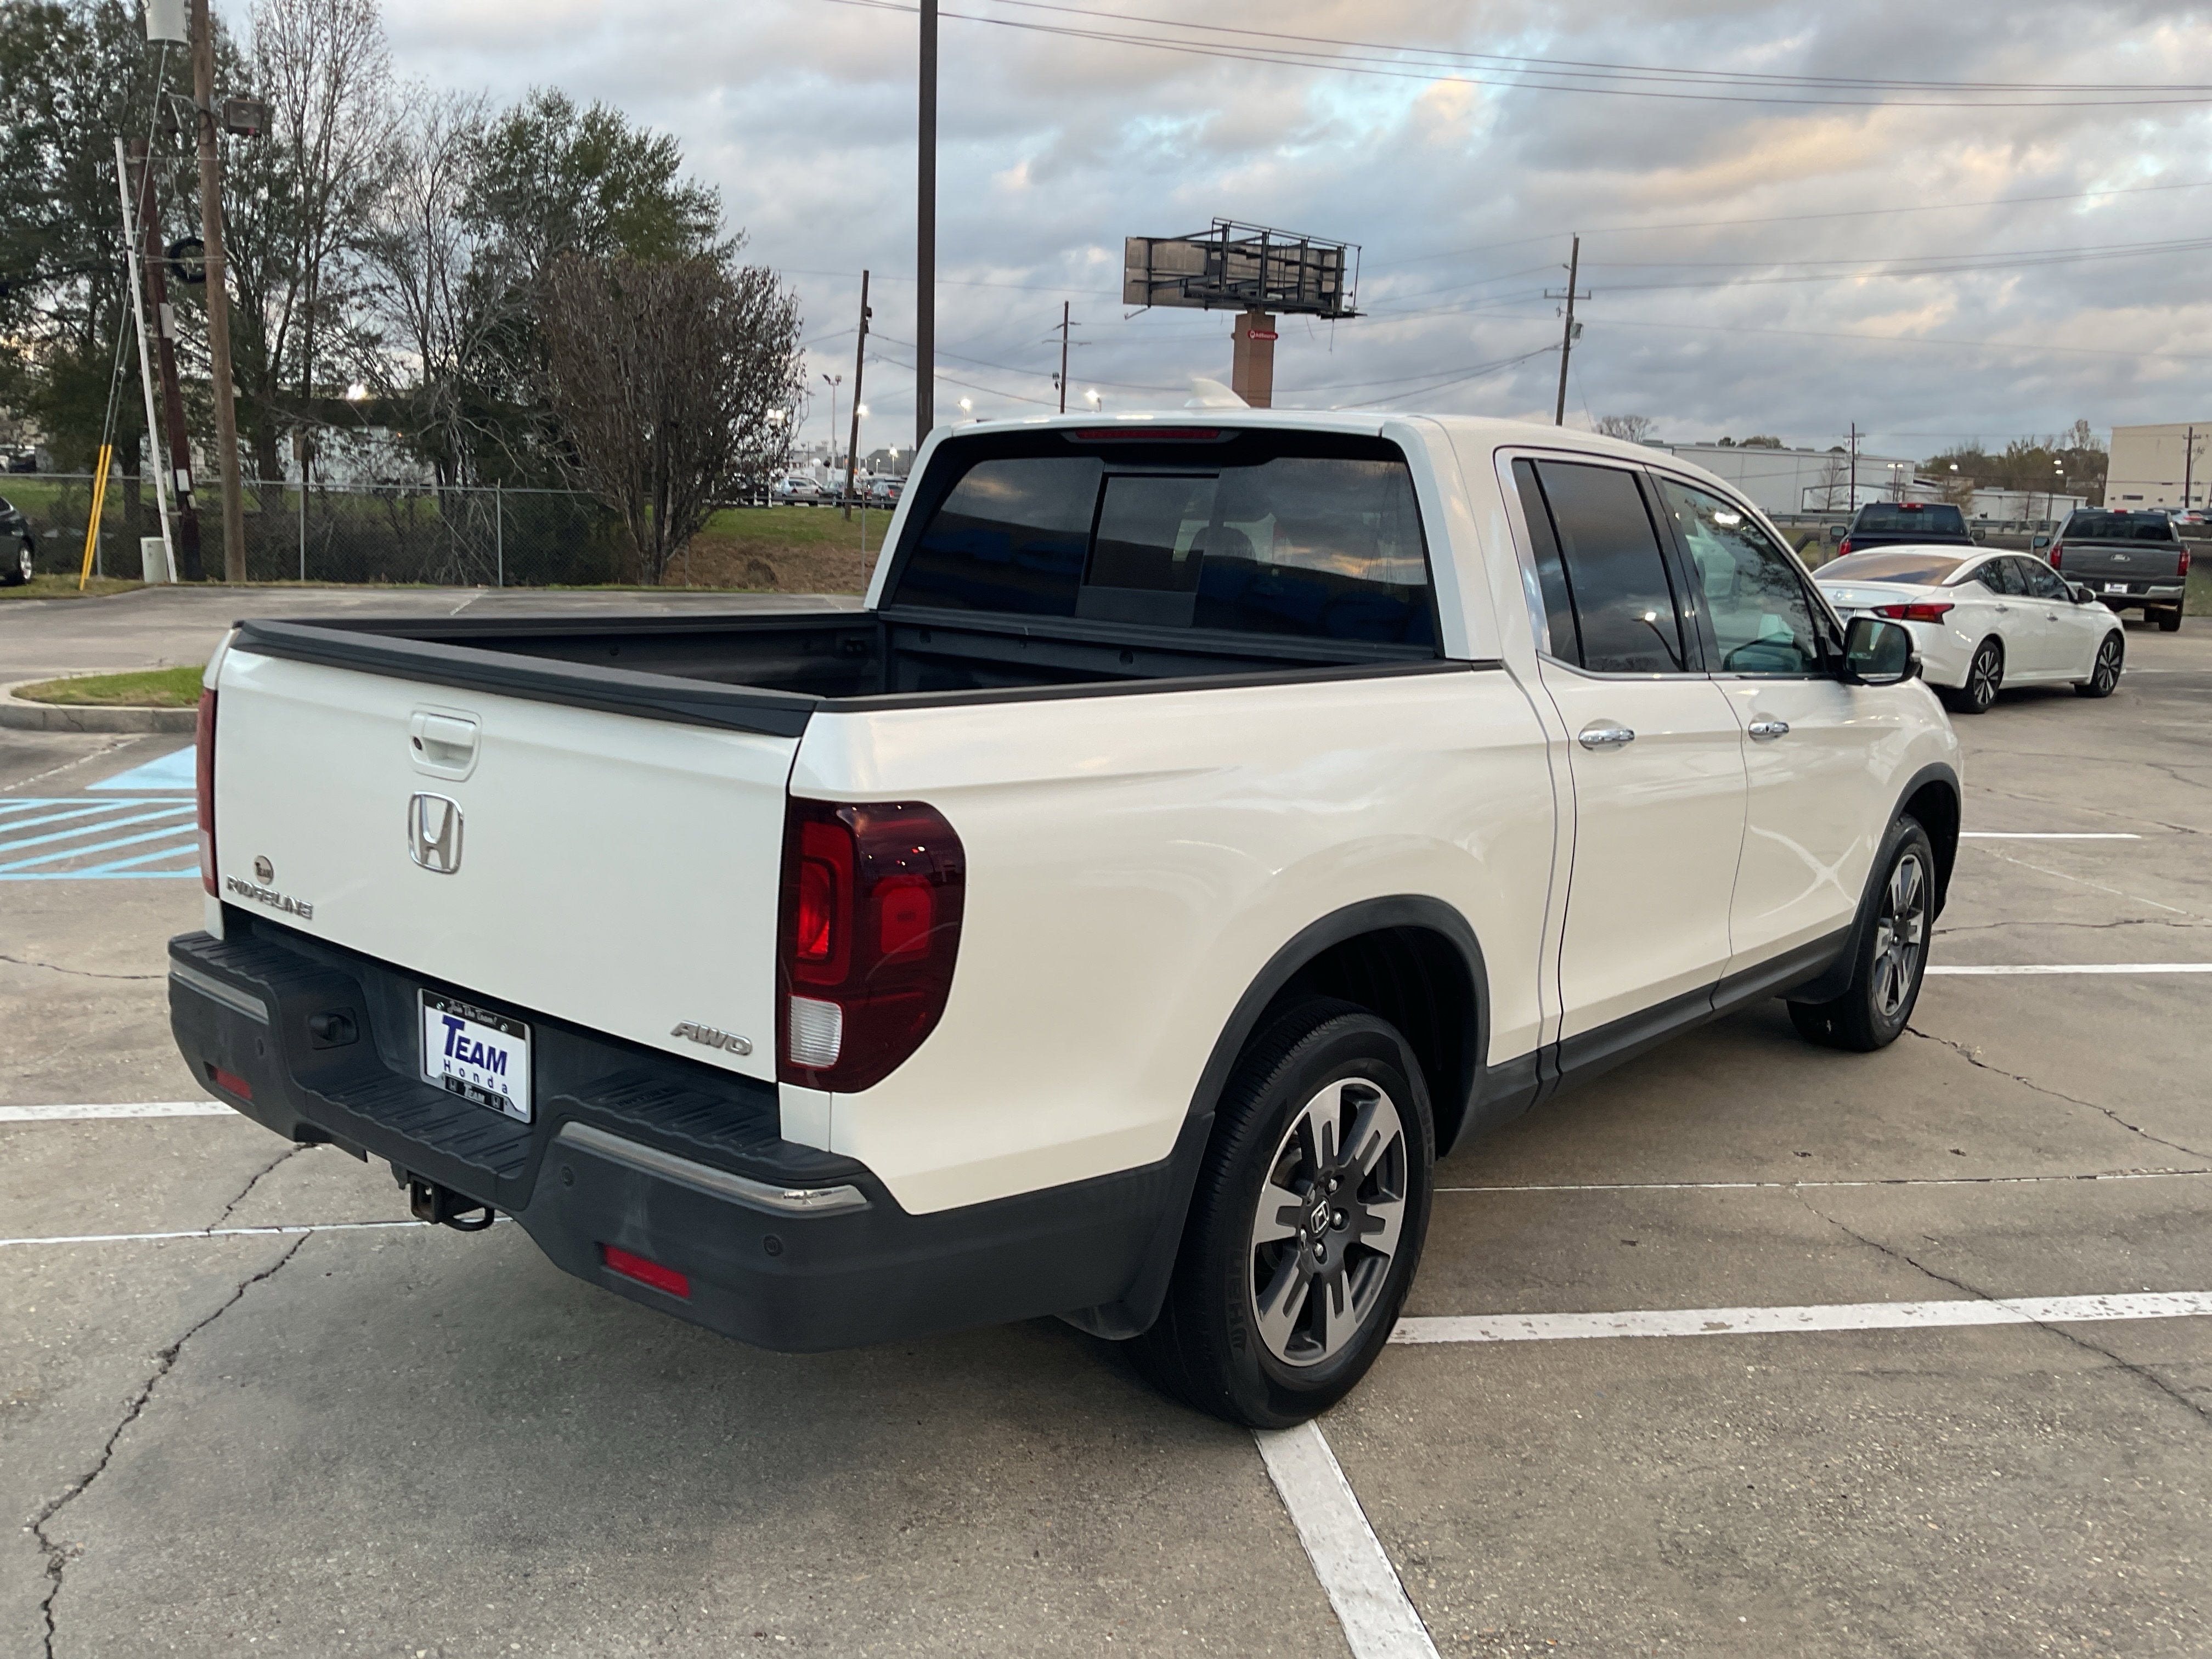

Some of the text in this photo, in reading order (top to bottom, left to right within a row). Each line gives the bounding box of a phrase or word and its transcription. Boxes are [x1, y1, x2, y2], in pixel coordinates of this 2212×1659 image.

[227, 874, 314, 921] RIDGELINE
[442, 1014, 507, 1076] TEAM
[670, 1020, 753, 1056] AWD
[443, 1058, 508, 1094] Honda
